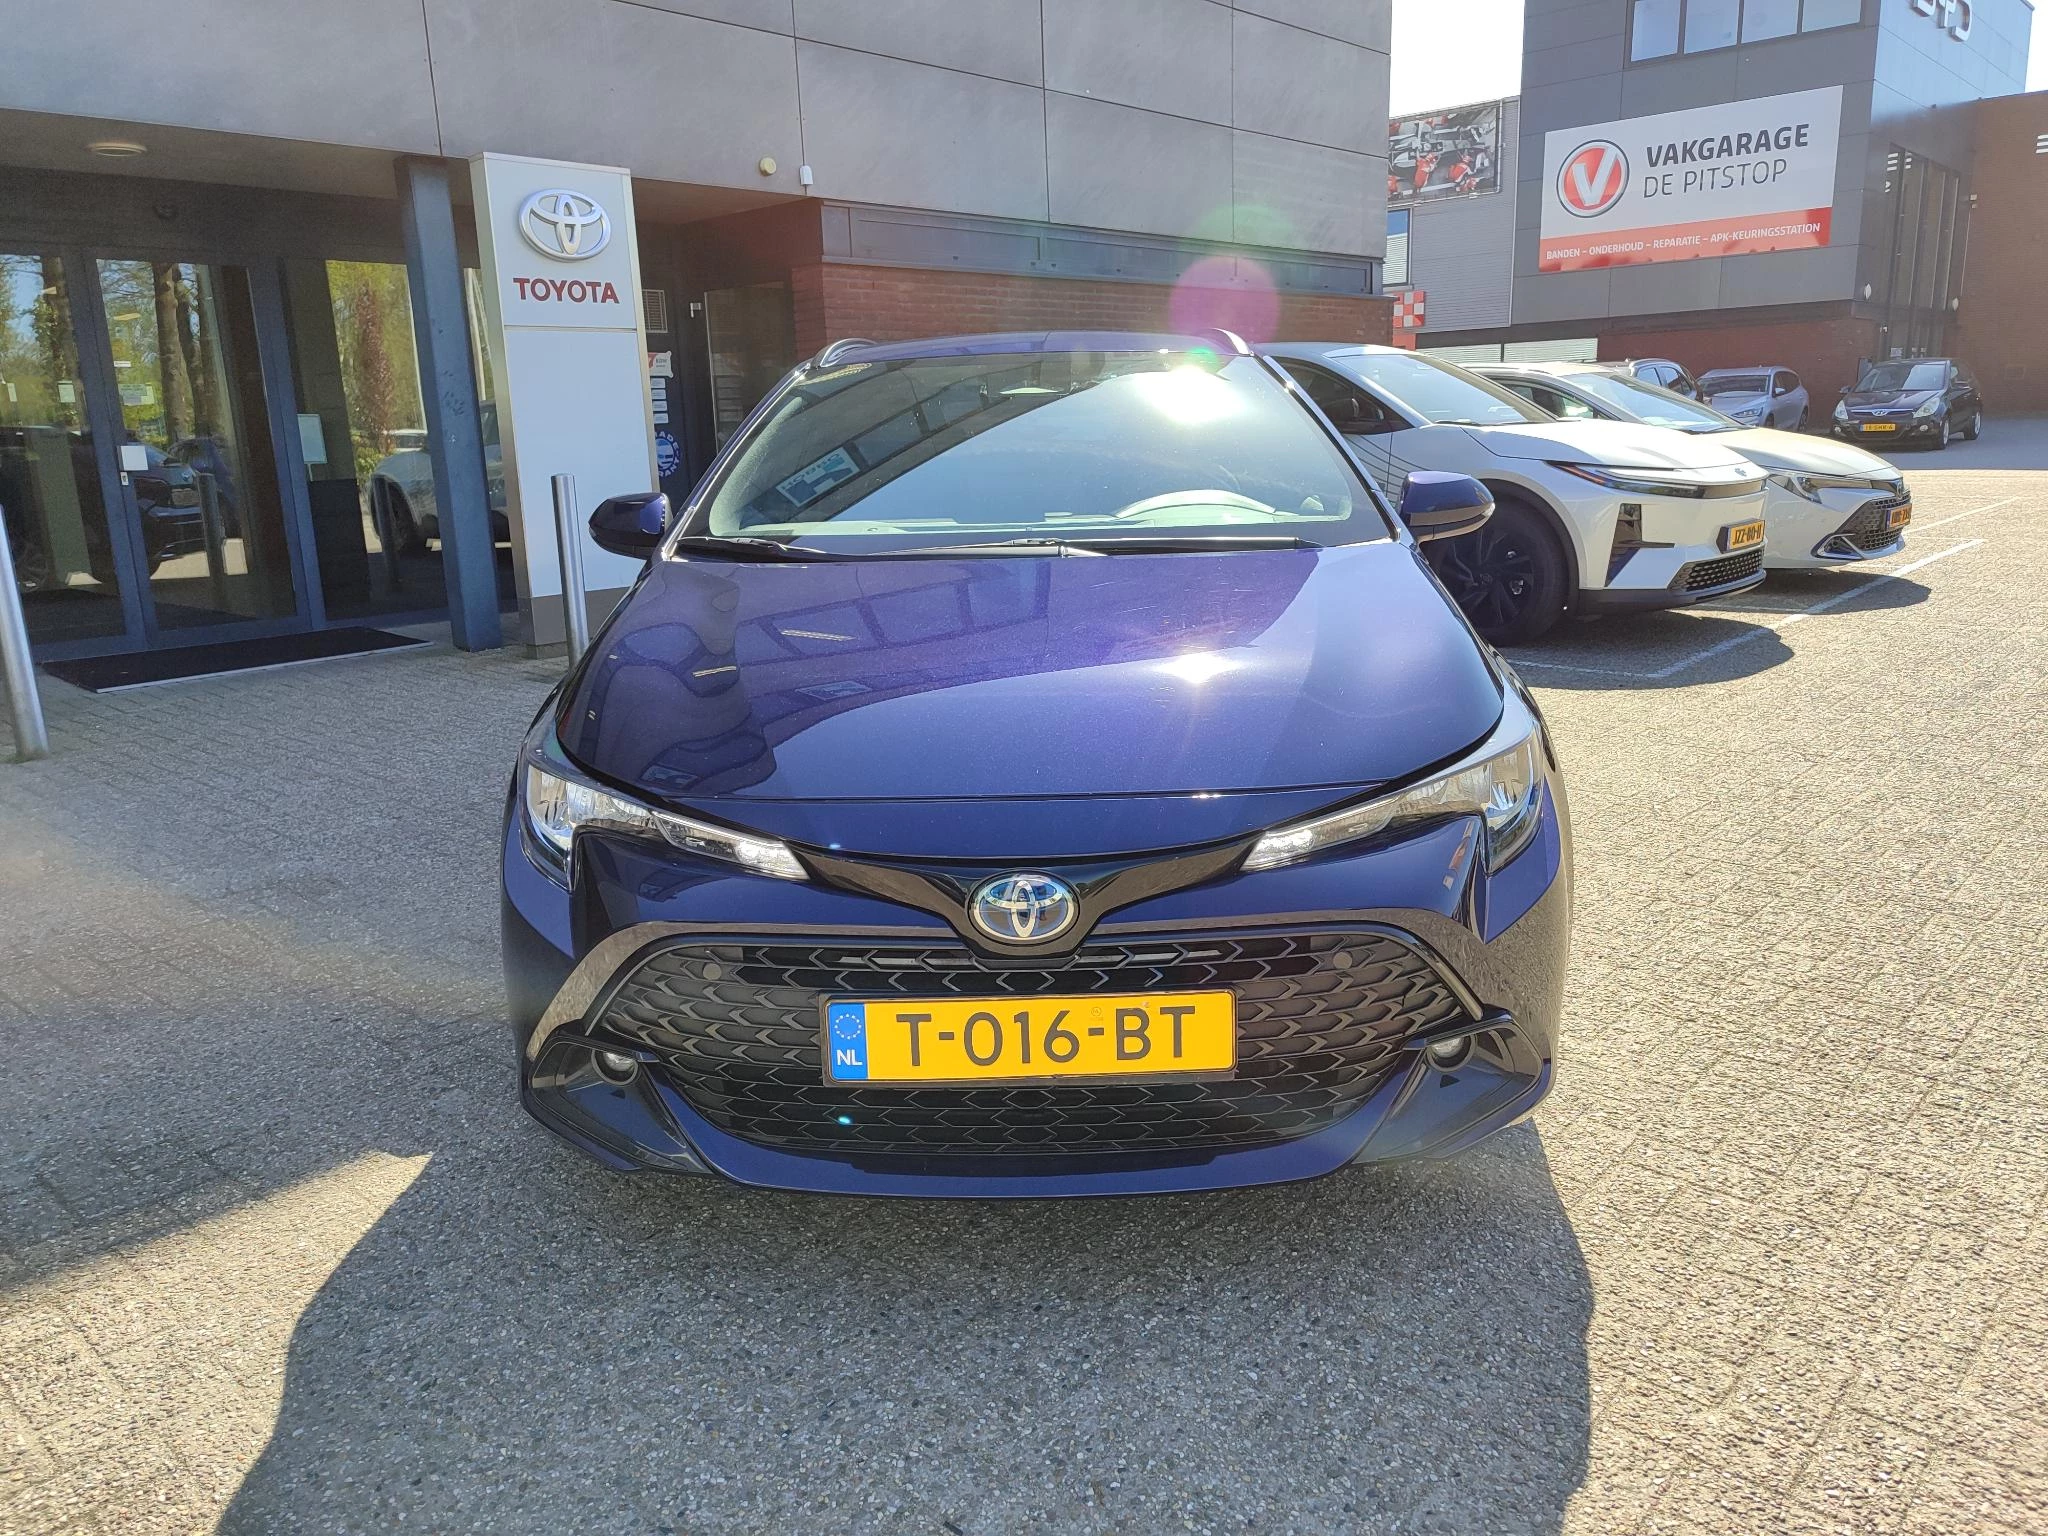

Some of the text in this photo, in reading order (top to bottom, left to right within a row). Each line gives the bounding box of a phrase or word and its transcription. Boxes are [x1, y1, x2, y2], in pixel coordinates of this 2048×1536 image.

[1646, 123, 1809, 168] VAKGARAGE
[1643, 158, 1787, 199] DE PITSTOP
[1546, 248, 1580, 260] BANDEN
[1589, 241, 1644, 256] ONDERHOUD
[1653, 234, 1700, 249] REPARATIE
[1710, 222, 1821, 243] APK-KEURINGSSTATION
[513, 277, 620, 304] TOYOTA
[896, 1006, 1195, 1067] T-016-BT
[836, 1049, 863, 1066] NL
